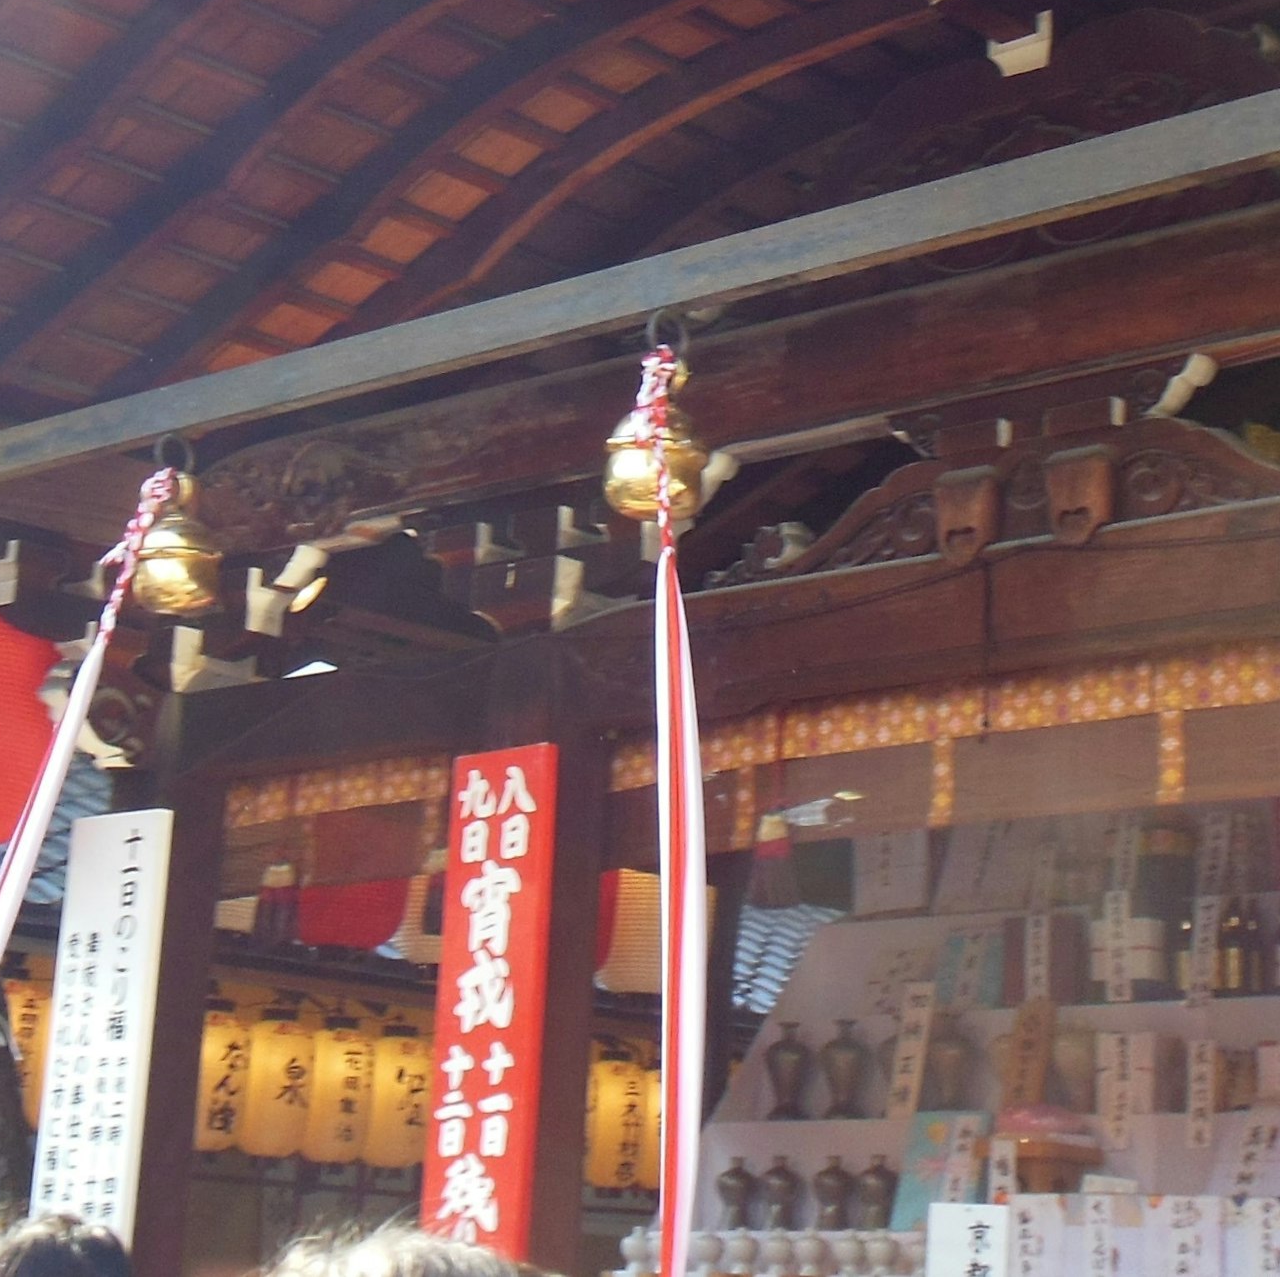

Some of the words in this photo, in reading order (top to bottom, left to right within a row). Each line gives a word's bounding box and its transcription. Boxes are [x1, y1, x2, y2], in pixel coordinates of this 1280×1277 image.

[458, 769, 497, 863] 九日
[497, 766, 538, 859] 八日
[434, 1045, 475, 1157] 十二日
[477, 1041, 515, 1157] 十一日
